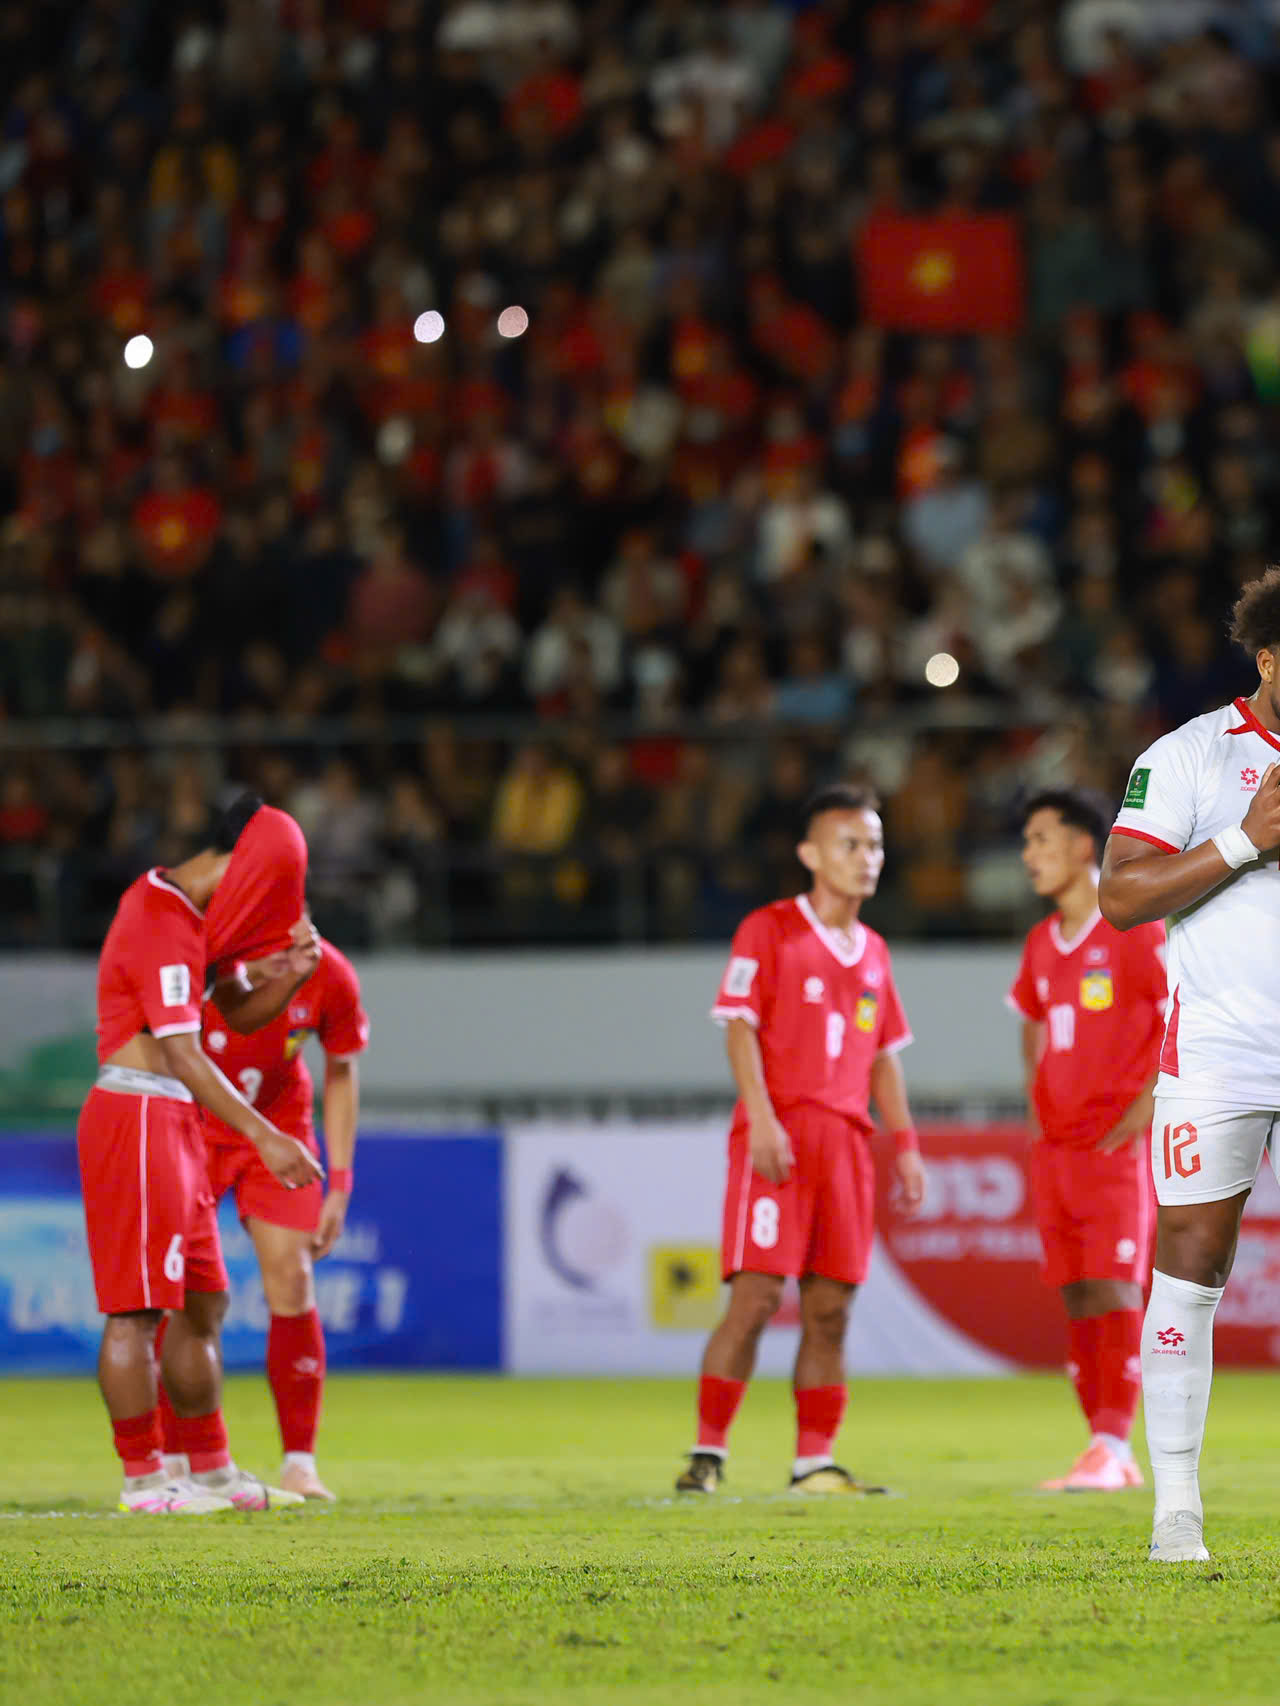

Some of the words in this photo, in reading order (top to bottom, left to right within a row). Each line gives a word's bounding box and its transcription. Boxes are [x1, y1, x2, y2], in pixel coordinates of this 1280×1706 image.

[1163, 1121, 1201, 1179] 12
[751, 1196, 780, 1249] 8
[164, 1233, 185, 1282] 6
